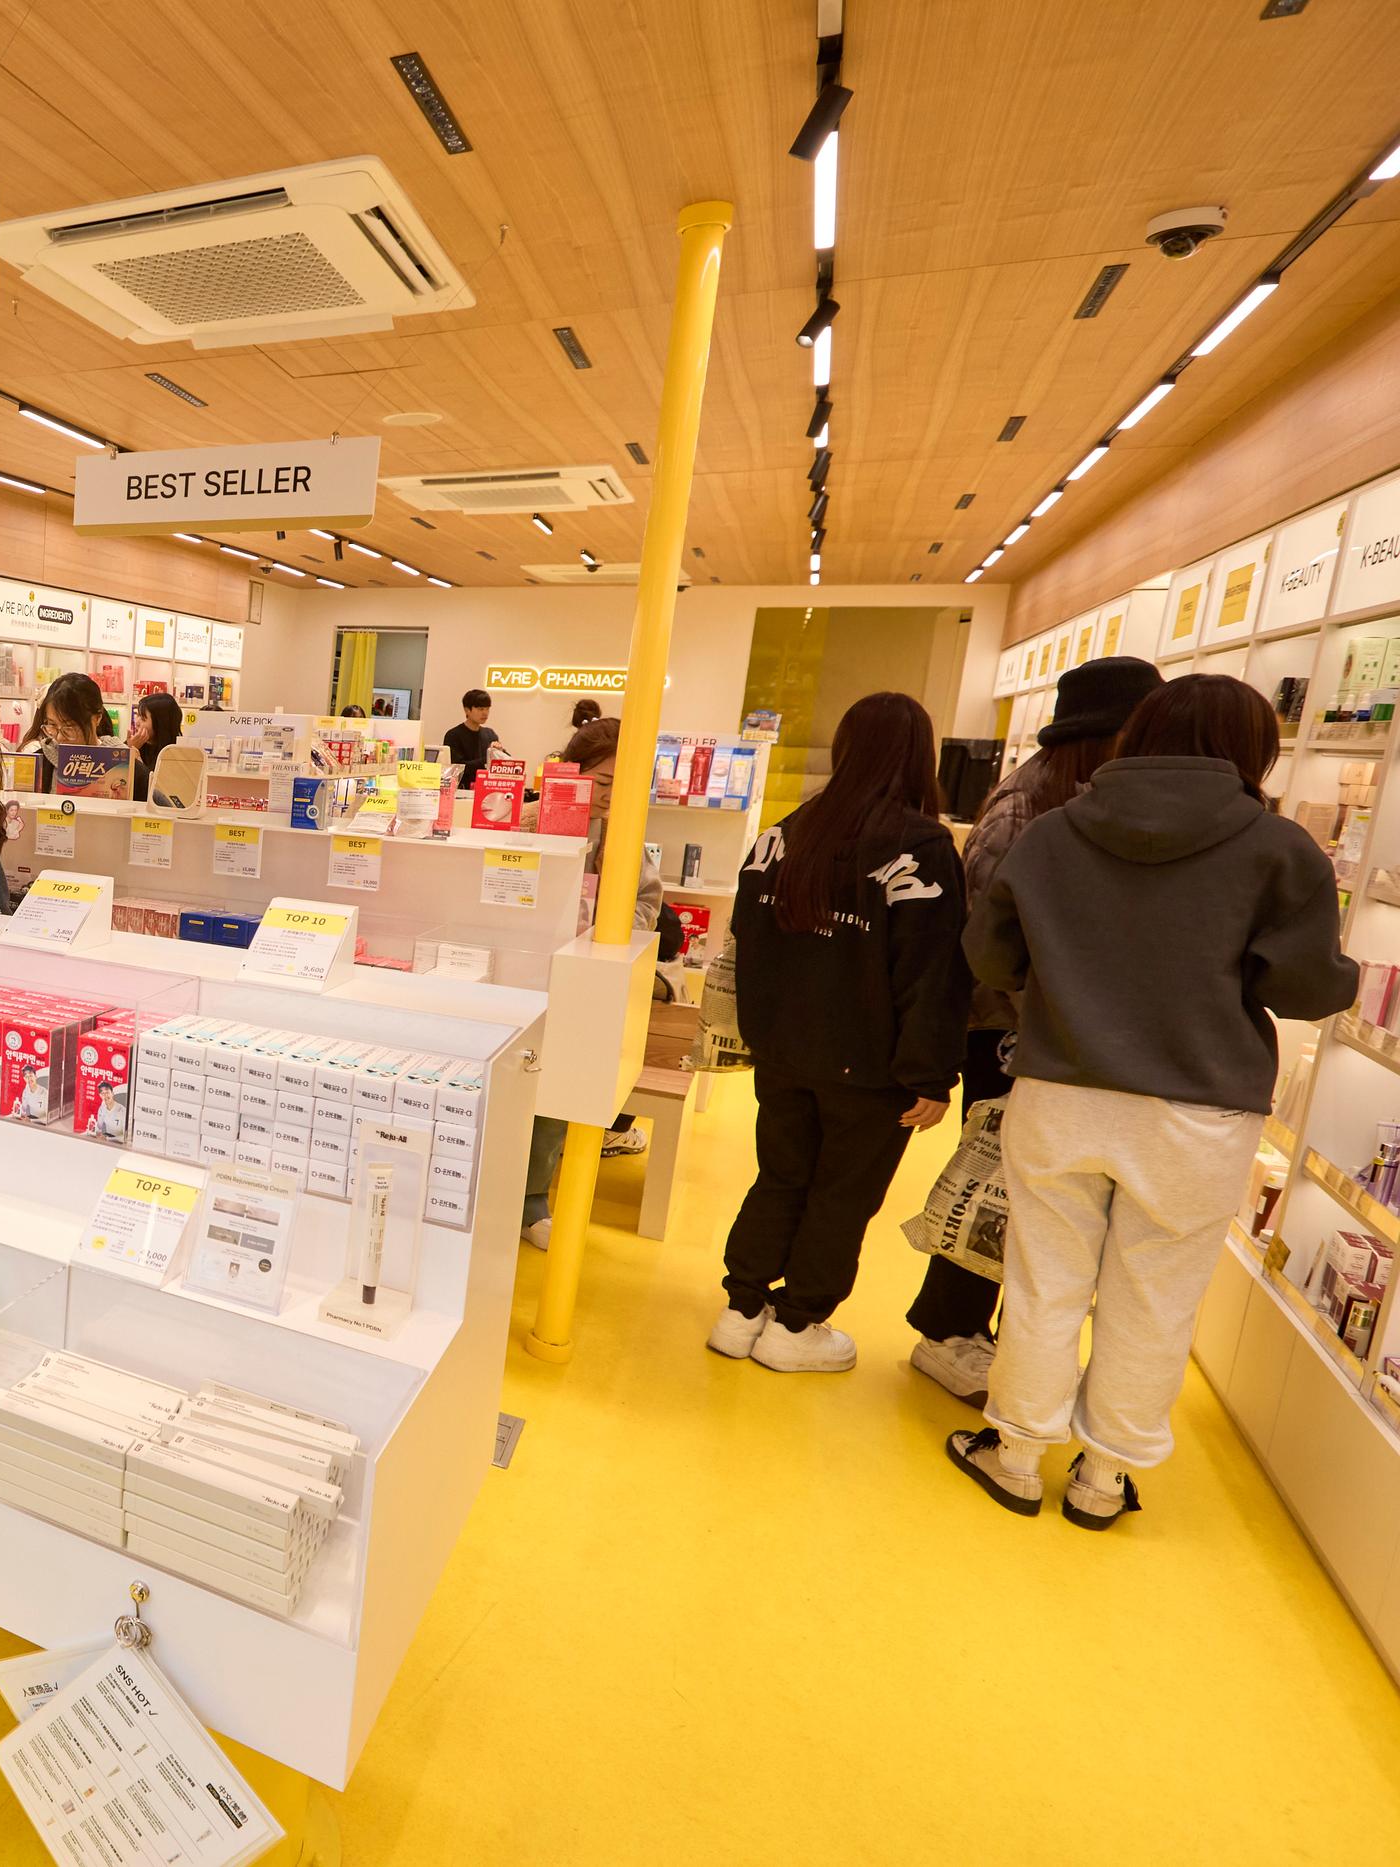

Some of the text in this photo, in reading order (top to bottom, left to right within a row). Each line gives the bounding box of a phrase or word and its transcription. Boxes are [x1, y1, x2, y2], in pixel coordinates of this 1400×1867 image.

[125, 465, 312, 501] BEST SELLER
[1359, 535, 1400, 569] K-BEAU
[1280, 561, 1325, 594] K-BEAUTY
[16, 603, 35, 618] PICK
[546, 673, 627, 688] PHARMAC
[253, 717, 273, 726] PICK
[63, 761, 106, 778] 아렉스
[49, 813, 64, 821] BEST
[145, 821, 160, 829] BEST
[228, 829, 246, 838] BEST
[348, 840, 367, 849] BEST
[501, 854, 523, 863] BEST
[52, 883, 72, 892] TOP
[285, 913, 326, 926] TOP 10
[711, 1033, 738, 1050] THE
[380, 1131, 408, 1144] Reju-All
[136, 1178, 172, 1196] TOP 5
[232, 1176, 269, 1191] Rejuvenating
[269, 1185, 289, 1195] Cream
[326, 1312, 353, 1325] Pharmacy
[115, 1664, 152, 1708] SNS HOT
